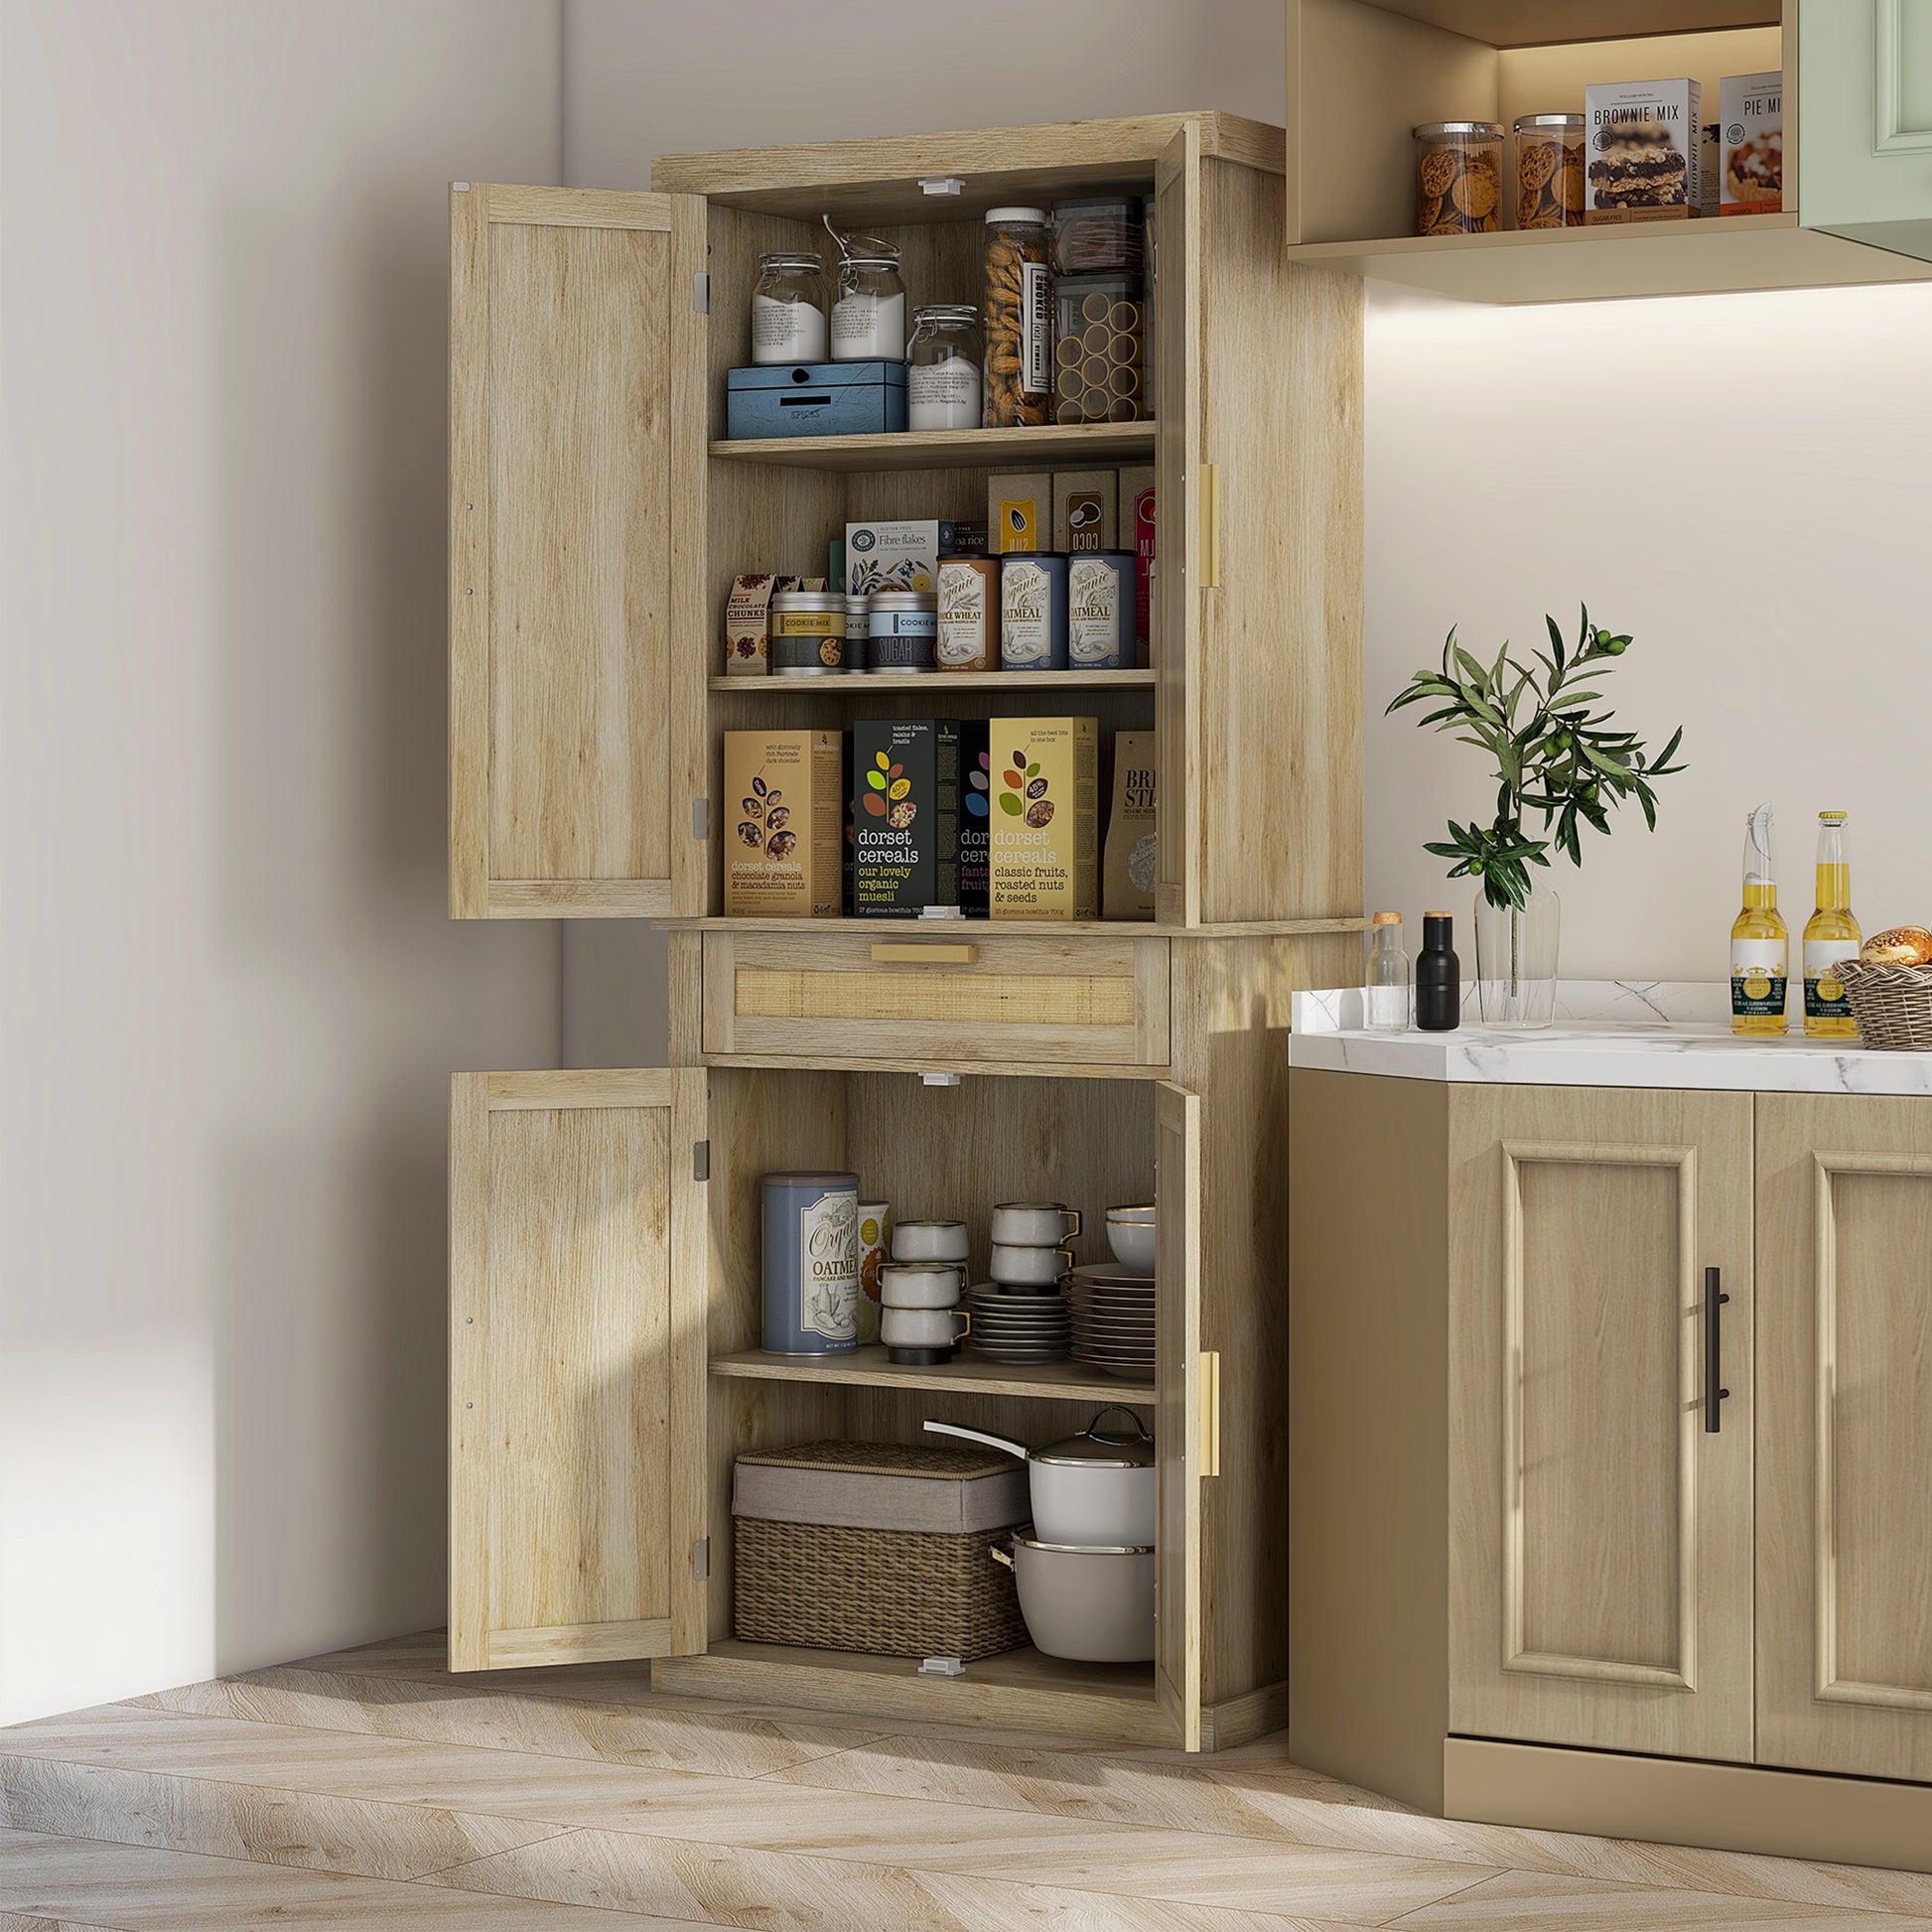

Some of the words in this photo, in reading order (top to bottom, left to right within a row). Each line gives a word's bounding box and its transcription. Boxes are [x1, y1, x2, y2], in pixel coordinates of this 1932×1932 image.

[1744, 99, 1762, 116] PIE
[1768, 97, 1781, 113] MI
[1593, 106, 1650, 125] BROWNIE
[1657, 104, 1679, 121] MIX
[880, 534, 900, 546] Fibre
[901, 533, 926, 545] flakes
[967, 535, 985, 545] rice
[728, 609, 765, 618] CHUNKS
[879, 637, 912, 661] SUGAR
[1124, 789, 1157, 807] STI
[858, 828, 912, 845] dorset
[960, 828, 990, 845] dor
[994, 829, 1050, 845] dorset
[858, 847, 919, 864] cereals
[960, 849, 990, 863] cer
[994, 848, 1057, 864] cereals
[731, 861, 764, 871] dorset
[764, 861, 802, 872] cereals
[858, 867, 878, 877] our
[880, 866, 911, 879] lovely
[961, 866, 990, 878] fanta
[995, 866, 1033, 878] classic
[1035, 866, 1068, 879] fruits,
[732, 872, 770, 881] chocolate
[771, 872, 803, 882] granola
[731, 881, 740, 890] &
[740, 881, 786, 890] macadamia
[858, 878, 899, 891] organic
[995, 880, 1036, 891] roasted
[1038, 881, 1064, 891] nuts
[858, 891, 896, 901] muesli
[995, 892, 1005, 902] &
[1007, 893, 1037, 903] seeds
